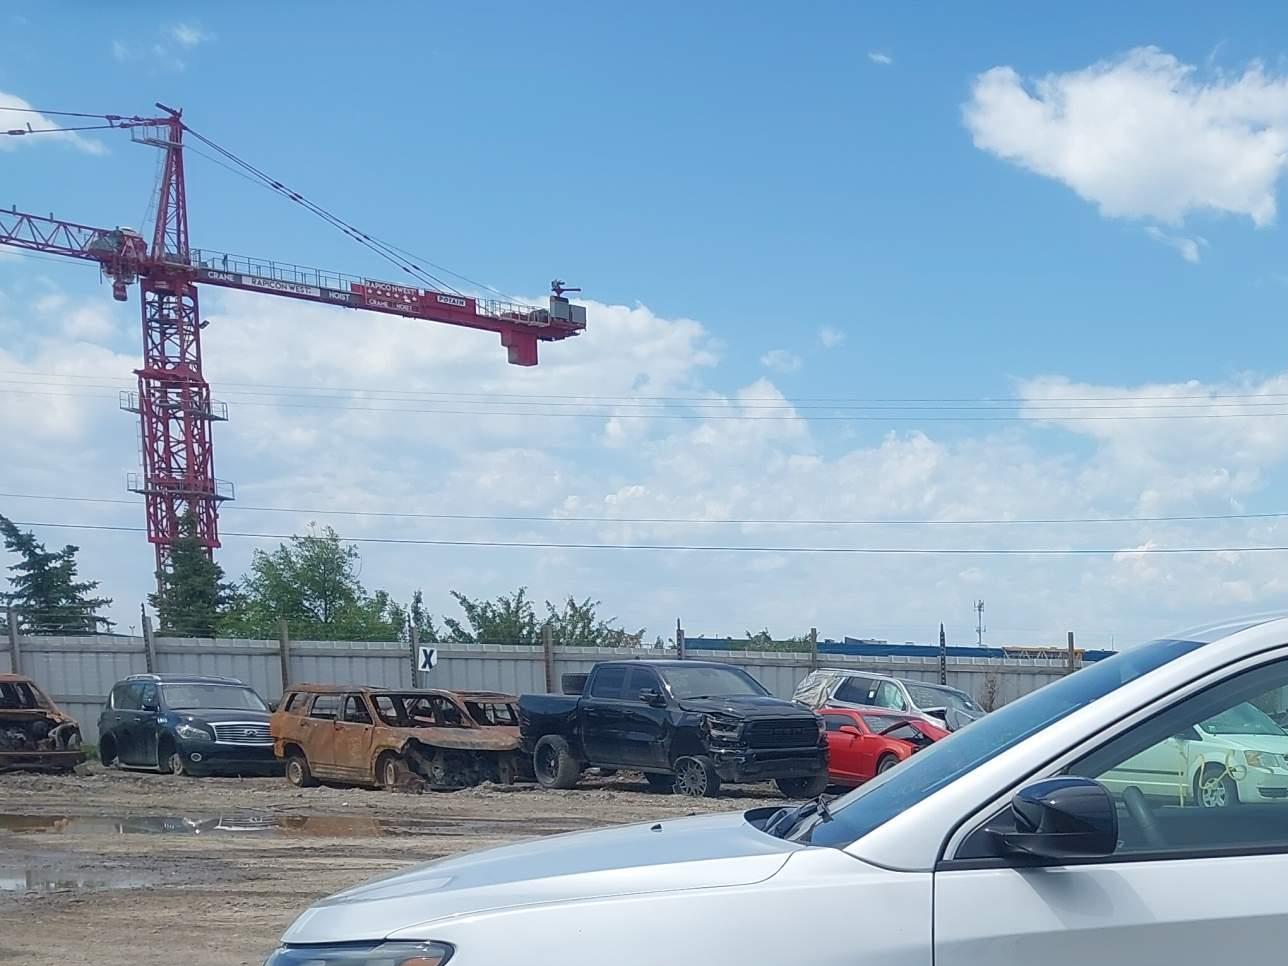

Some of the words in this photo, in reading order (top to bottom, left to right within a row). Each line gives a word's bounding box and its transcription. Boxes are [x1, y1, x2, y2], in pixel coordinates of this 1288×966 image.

[207, 270, 235, 282] CRANE
[328, 290, 350, 301] HOIST
[421, 649, 434, 670] X
